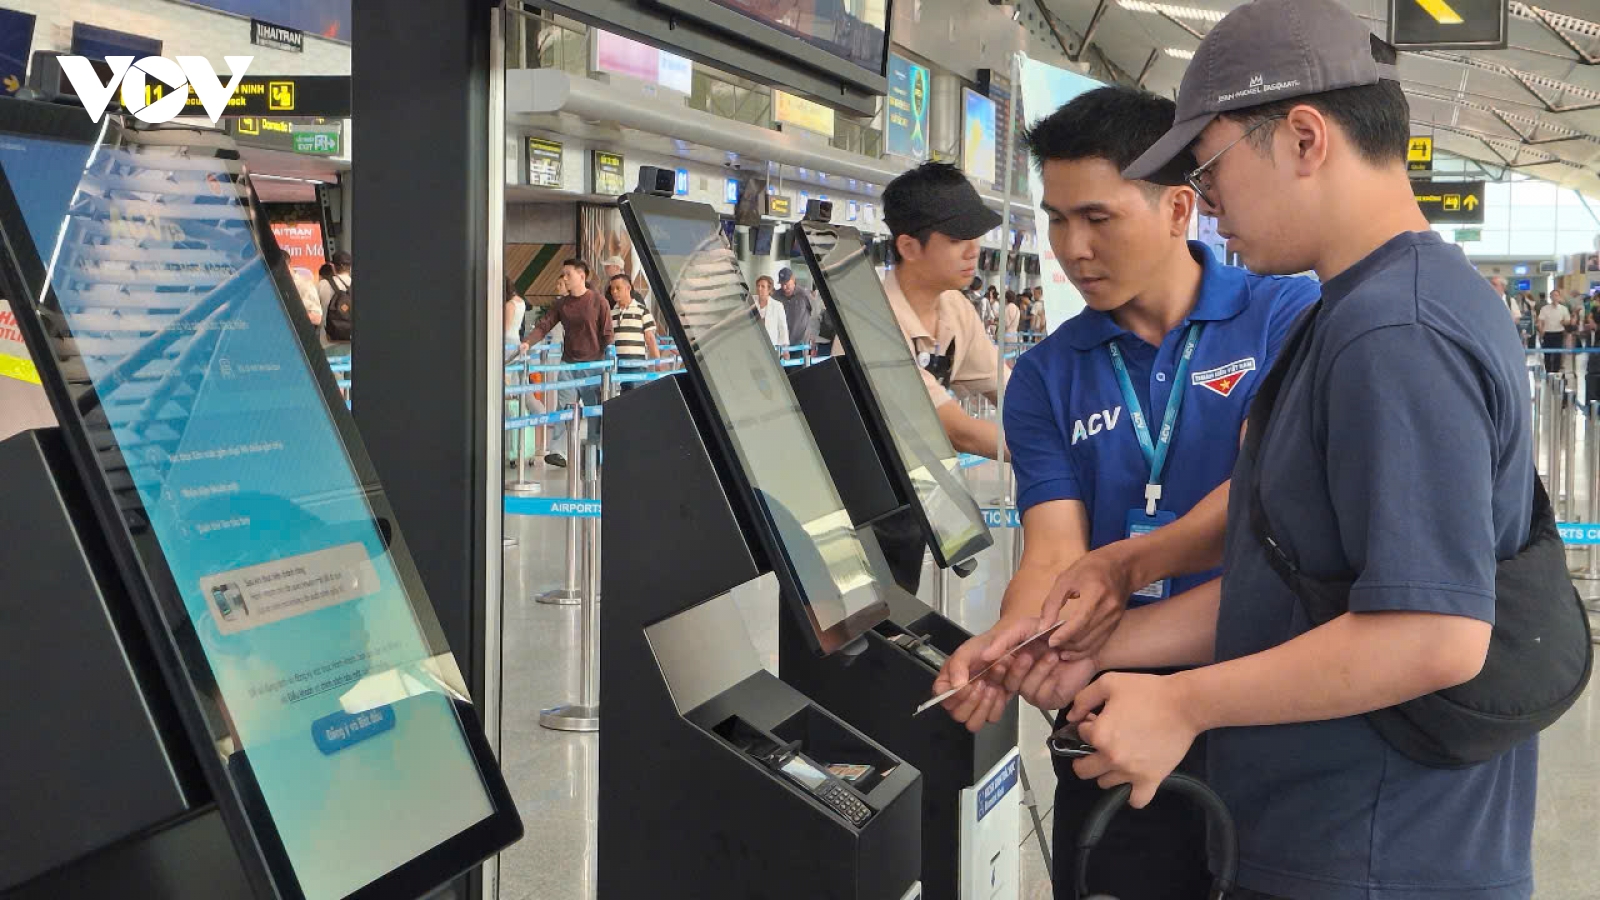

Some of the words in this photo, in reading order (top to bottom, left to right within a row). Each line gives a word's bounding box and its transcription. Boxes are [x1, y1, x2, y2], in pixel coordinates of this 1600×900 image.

[240, 83, 265, 95] NINH
[1070, 405, 1122, 446] ACV
[1160, 423, 1173, 444] ACV
